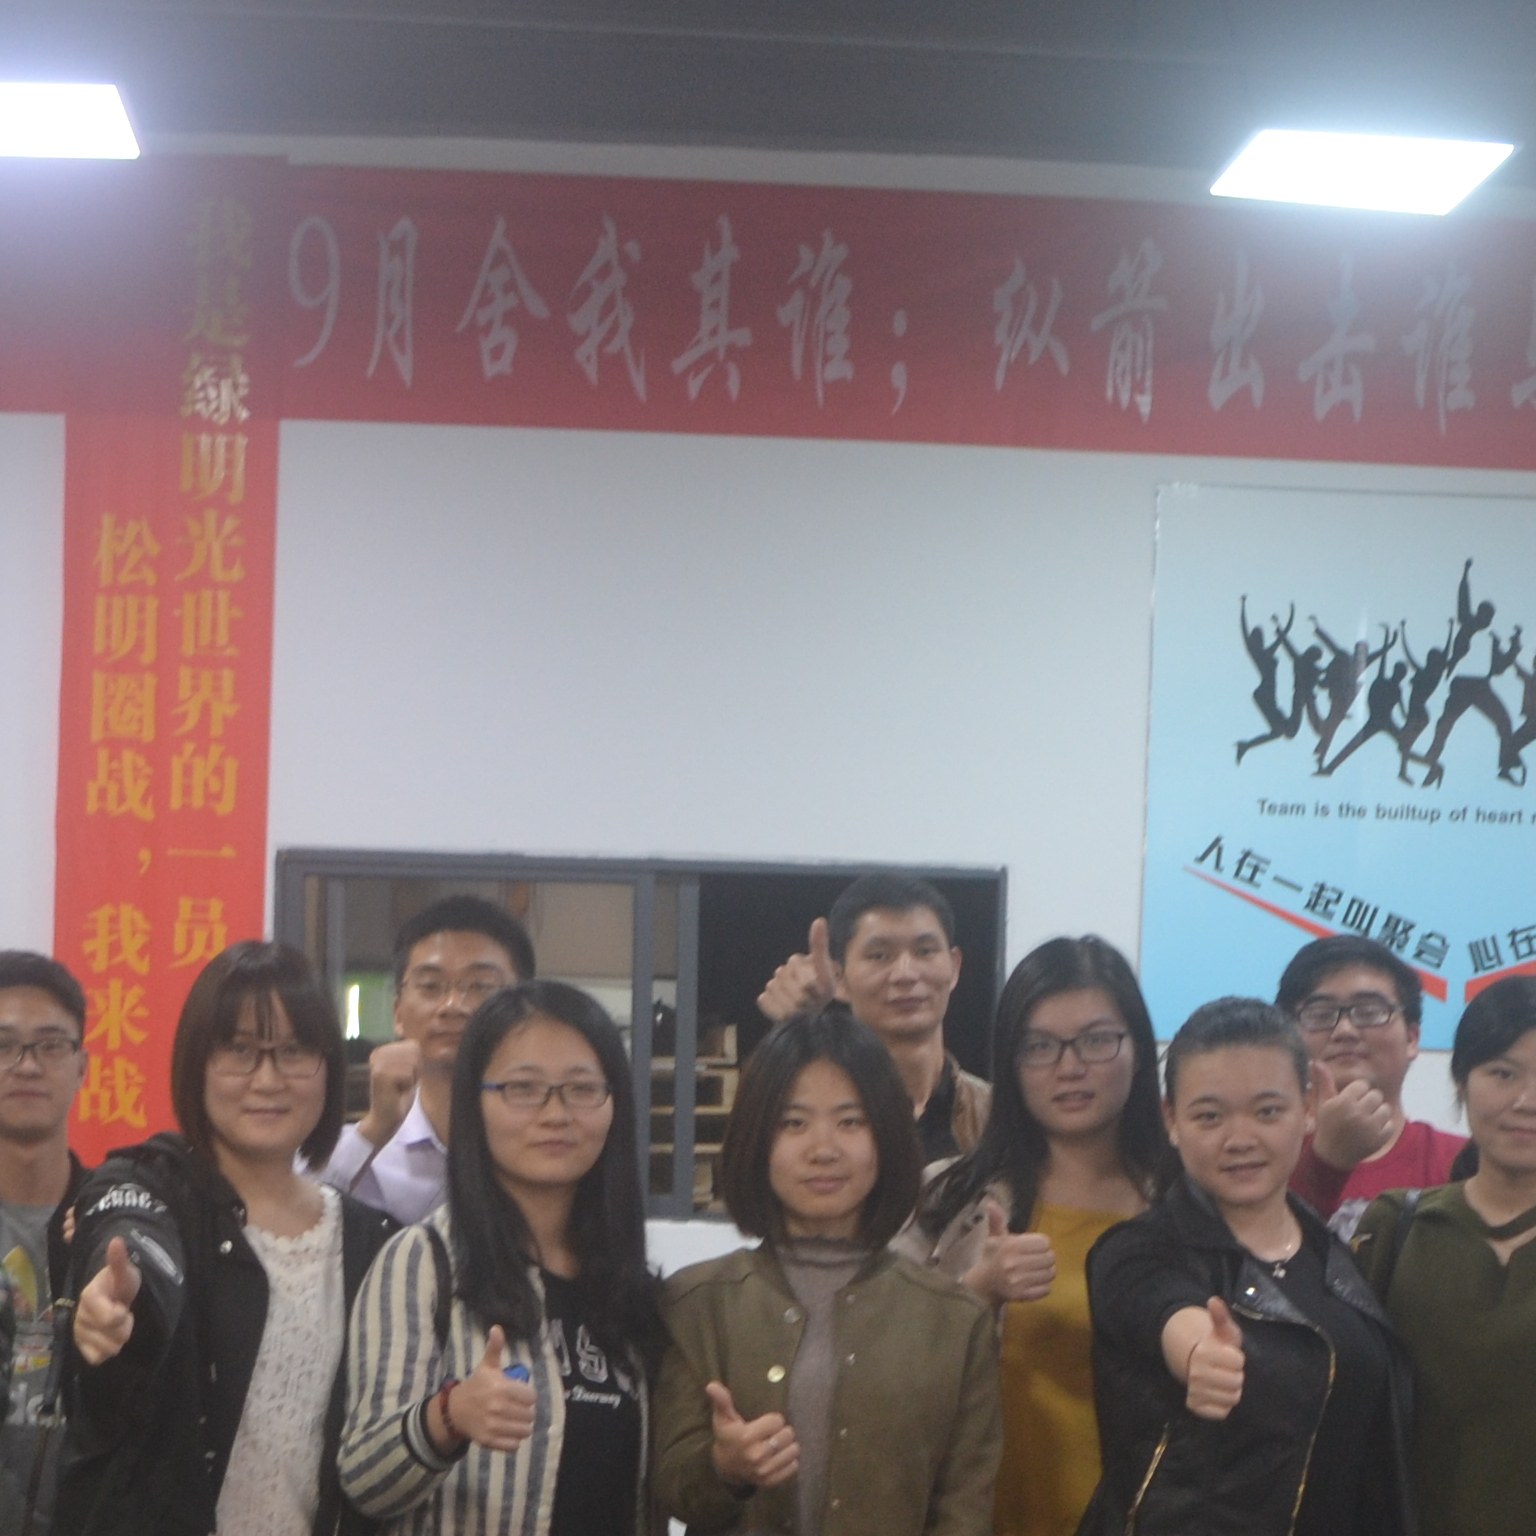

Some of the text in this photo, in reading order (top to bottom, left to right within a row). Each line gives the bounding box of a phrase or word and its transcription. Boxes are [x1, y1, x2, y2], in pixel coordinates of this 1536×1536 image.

[1257, 798, 1306, 817] Team
[1314, 799, 1331, 818] is
[1338, 800, 1367, 819] the
[1374, 802, 1442, 825] builtup
[1448, 804, 1468, 822] of
[1474, 806, 1523, 825] heart
[1193, 834, 1451, 970] 人在一起叫聚会
